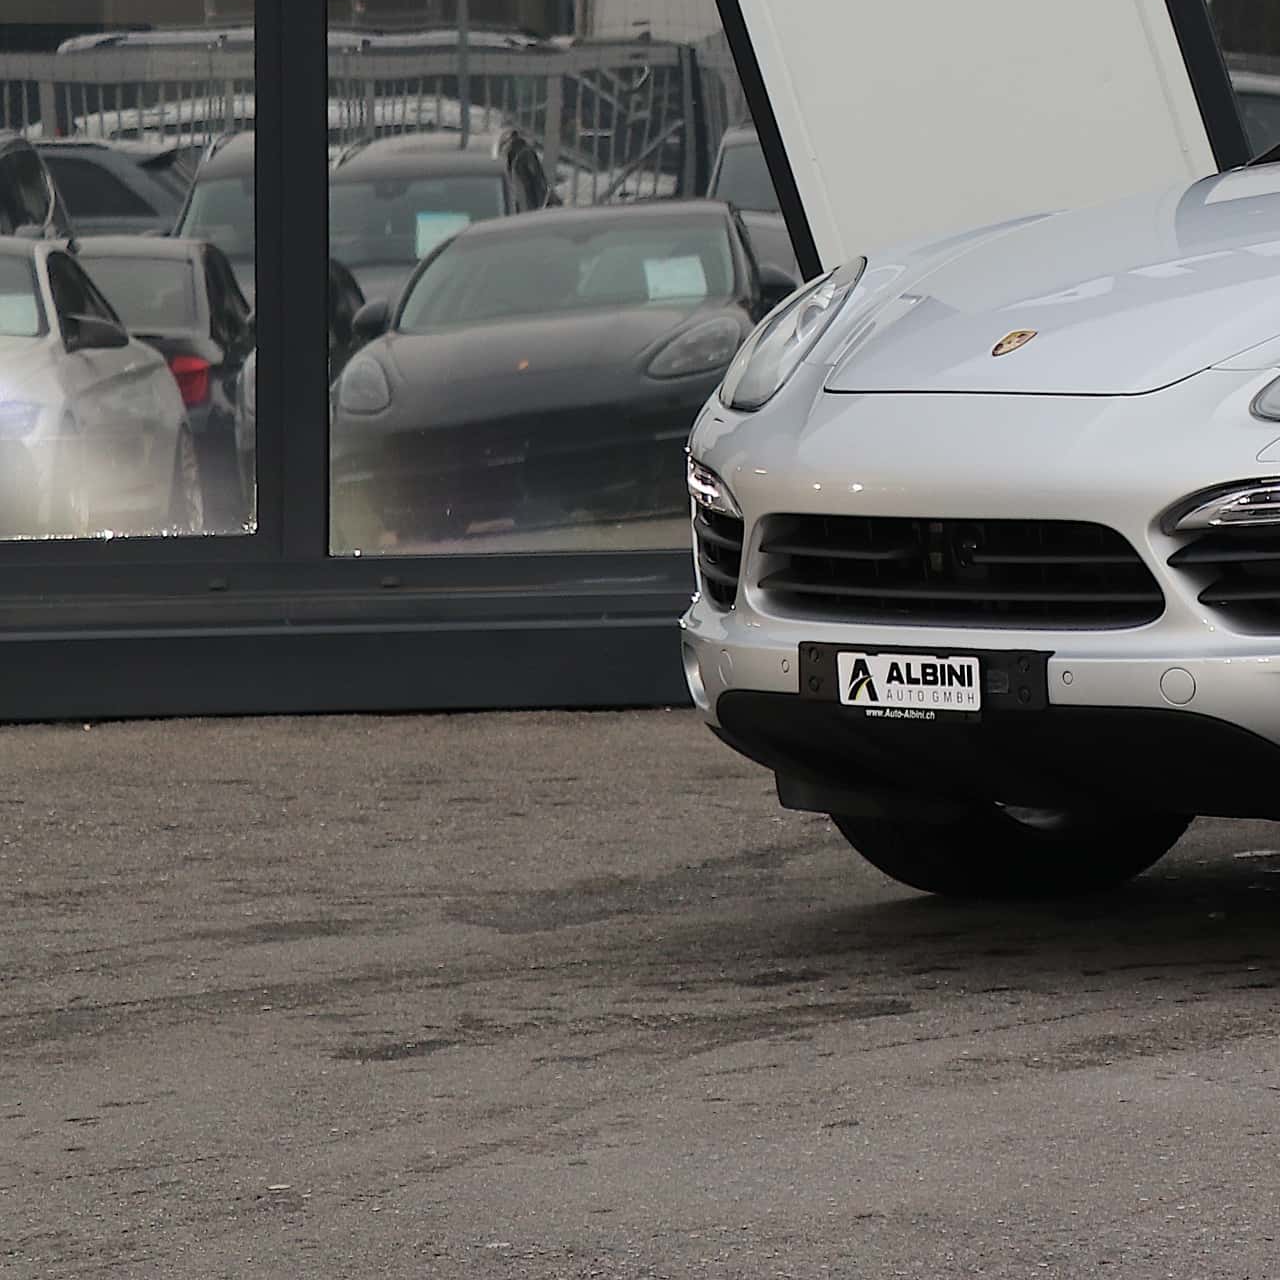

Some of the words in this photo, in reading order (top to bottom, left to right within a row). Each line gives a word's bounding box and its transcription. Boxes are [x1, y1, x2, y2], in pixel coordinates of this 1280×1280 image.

[886, 662, 973, 687] ALBINI
[886, 689, 925, 703] AUTO
[932, 691, 975, 704] GMBH
[865, 708, 936, 720] www.Auto-Albini.ch
